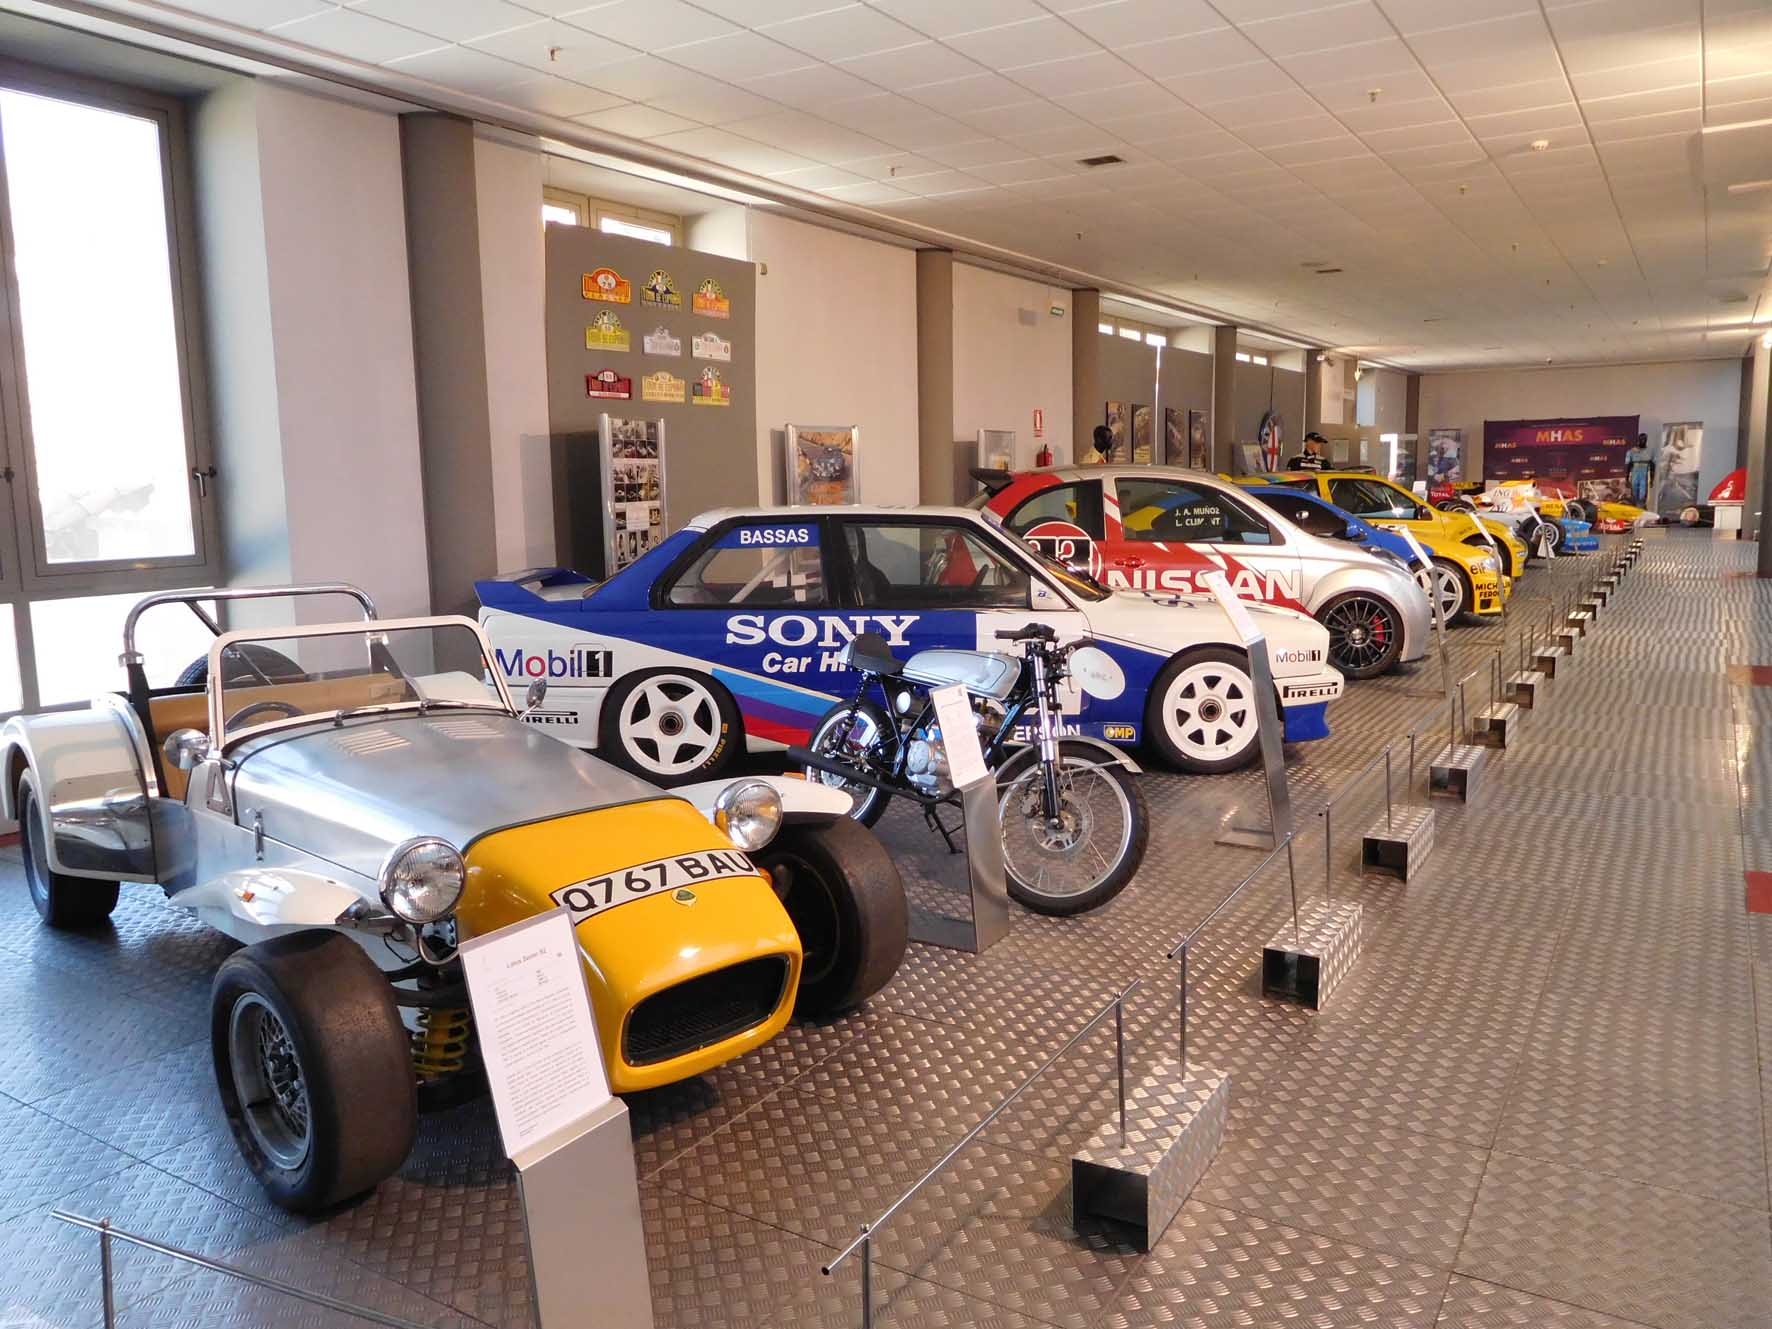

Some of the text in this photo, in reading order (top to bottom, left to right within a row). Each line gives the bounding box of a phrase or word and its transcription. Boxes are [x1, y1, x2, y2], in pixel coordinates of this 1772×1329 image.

[1535, 430, 1584, 442] MHAS
[740, 528, 809, 545] BASSAS
[726, 614, 920, 647] SONY
[762, 651, 812, 673] Car
[1282, 682, 1339, 698] PIRELLI
[675, 851, 755, 880] BAU
